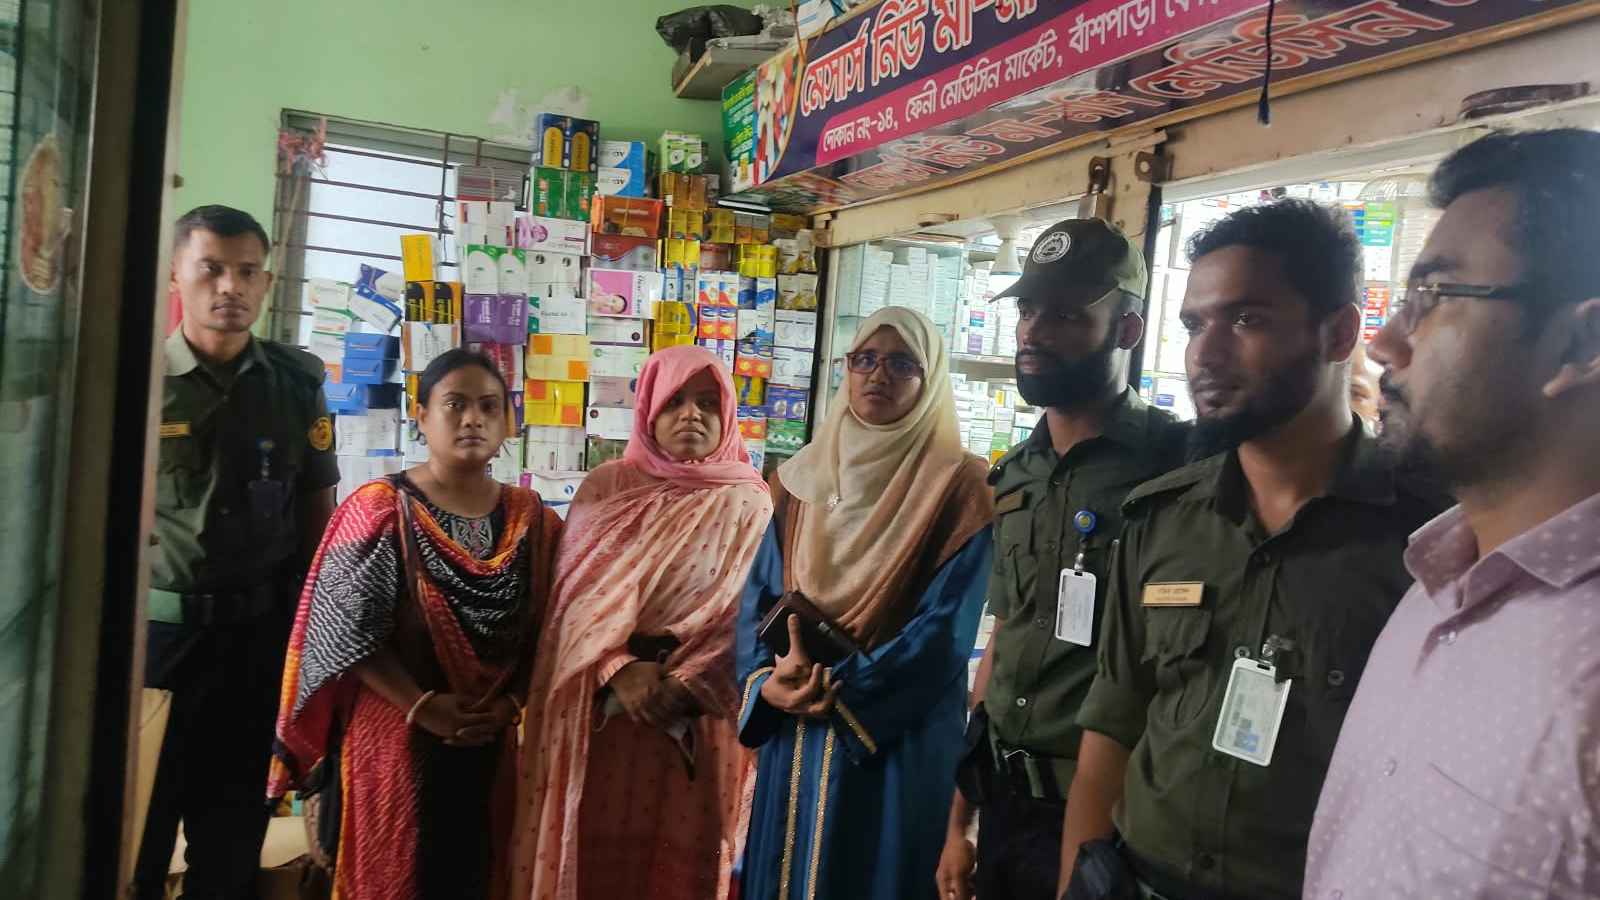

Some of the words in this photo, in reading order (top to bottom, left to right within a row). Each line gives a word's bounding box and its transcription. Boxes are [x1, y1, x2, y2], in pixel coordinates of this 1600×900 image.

[801, 17, 871, 117] মেসার্স
[871, 0, 929, 86] নিউ
[823, 121, 855, 153] দোকান
[905, 80, 937, 123] ফেনী
[940, 57, 1002, 110] মেডিসিন
[1004, 28, 1063, 82] মার্কেট,
